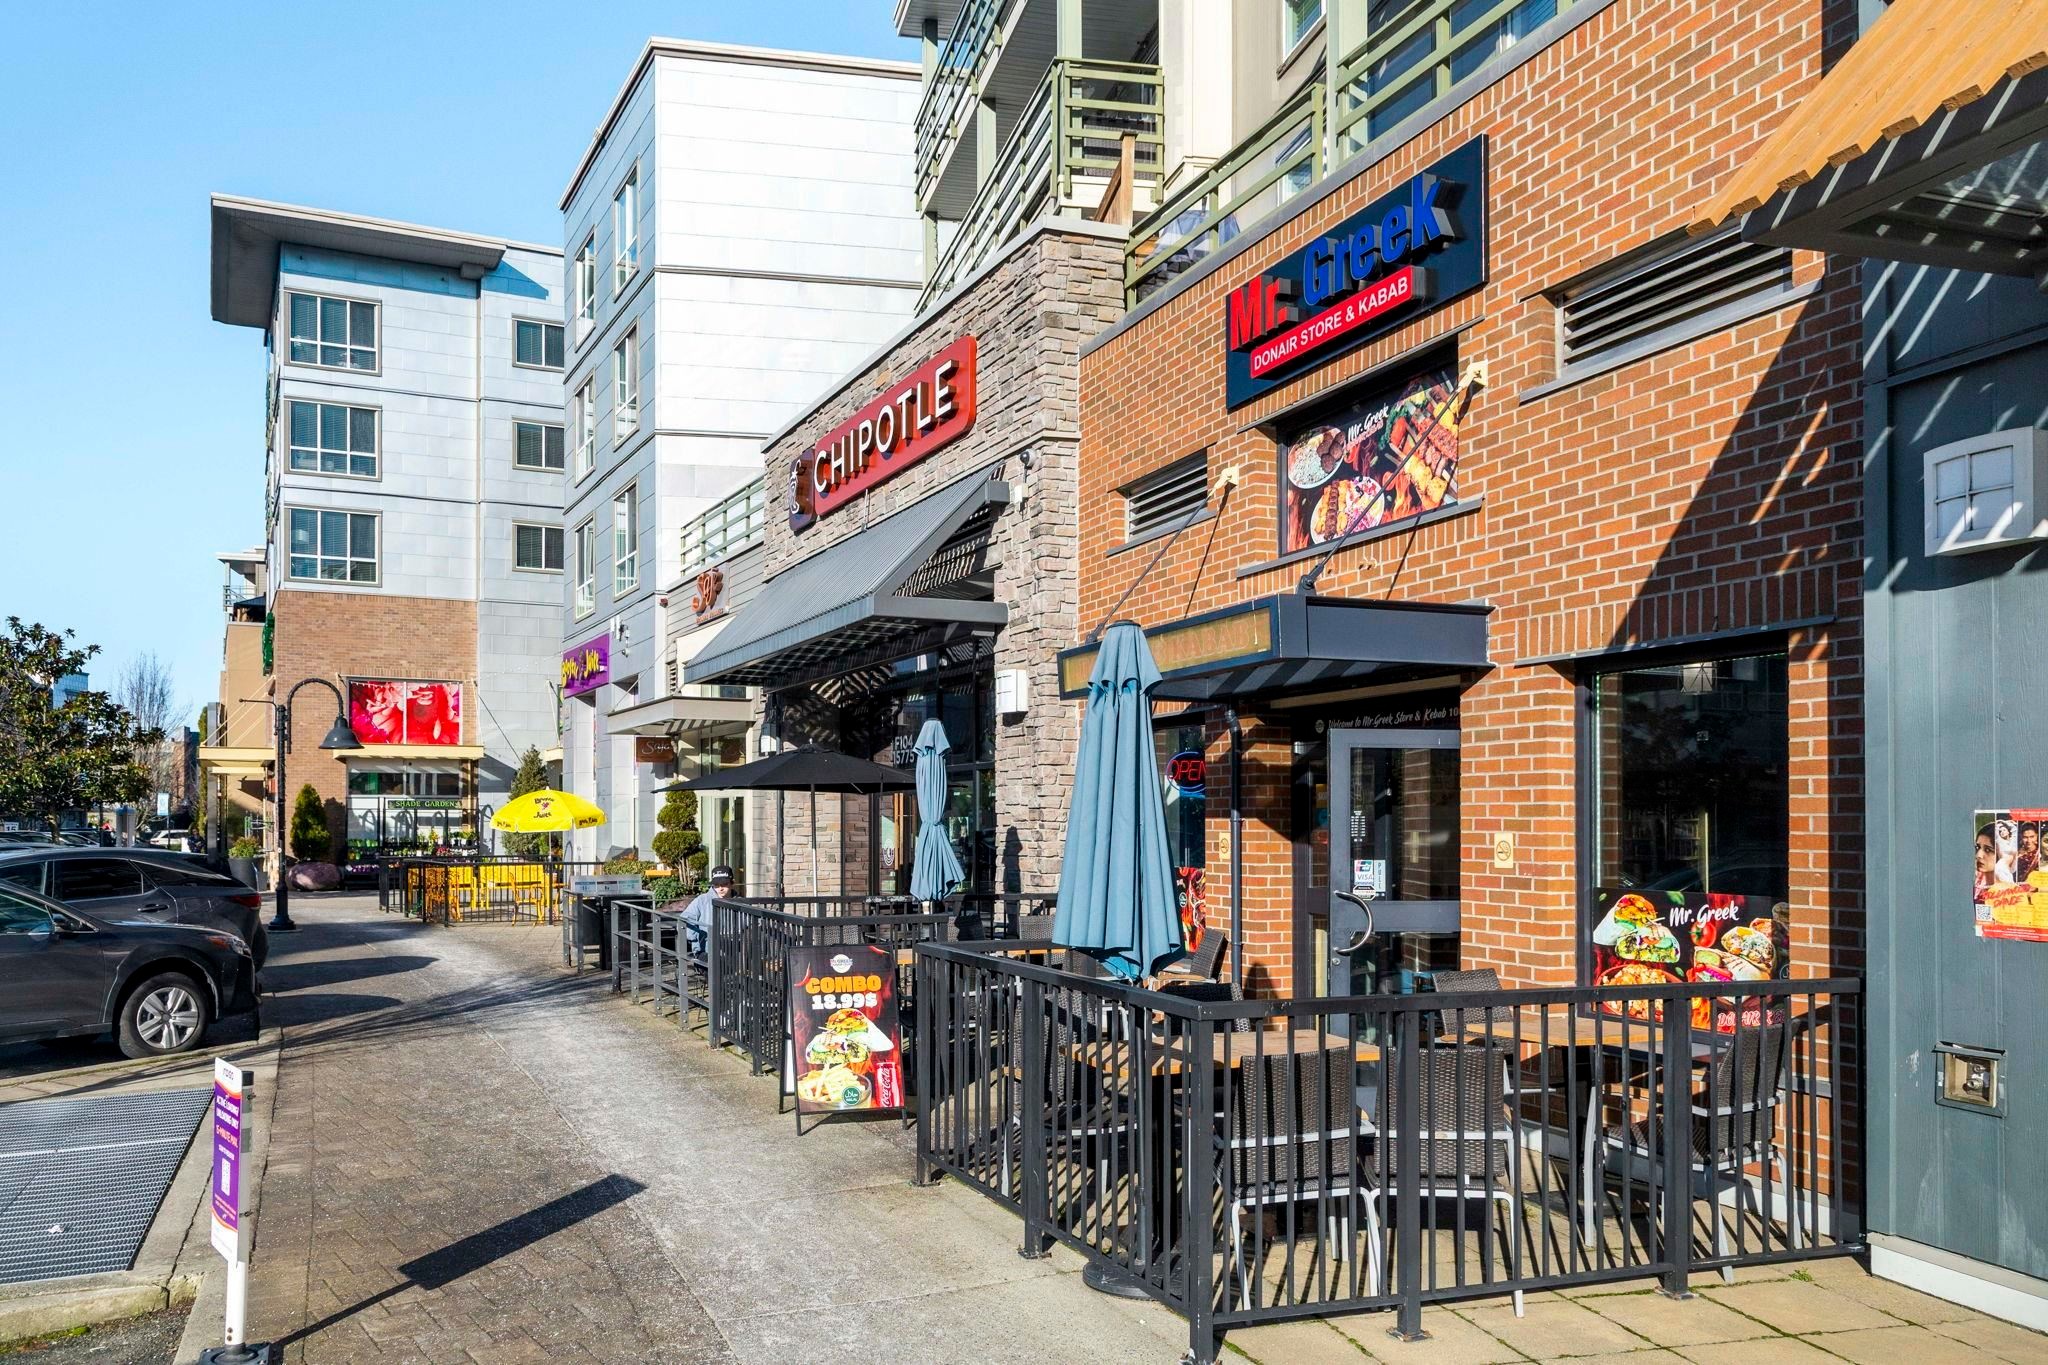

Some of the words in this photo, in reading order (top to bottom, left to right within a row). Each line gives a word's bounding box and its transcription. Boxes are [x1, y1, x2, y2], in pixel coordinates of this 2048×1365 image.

[1231, 275, 1288, 351] Mr.
[1303, 172, 1442, 306] Greek
[1254, 335, 1298, 371] DONAIR
[1300, 311, 1342, 346] STORE
[1345, 305, 1355, 323] &
[1358, 276, 1409, 316] KABAB
[813, 359, 954, 493] CHIPOTLE
[1347, 423, 1363, 442] Mr.
[1363, 403, 1389, 431] Greek
[1354, 716, 1361, 727] to
[1394, 711, 1414, 724] Store
[1414, 710, 1421, 721] &
[894, 735, 914, 751] F104
[1669, 906, 1695, 928] Mr.
[1696, 900, 1740, 929] Greek
[806, 974, 882, 995] COMBO
[811, 991, 878, 1010] 18.99$
